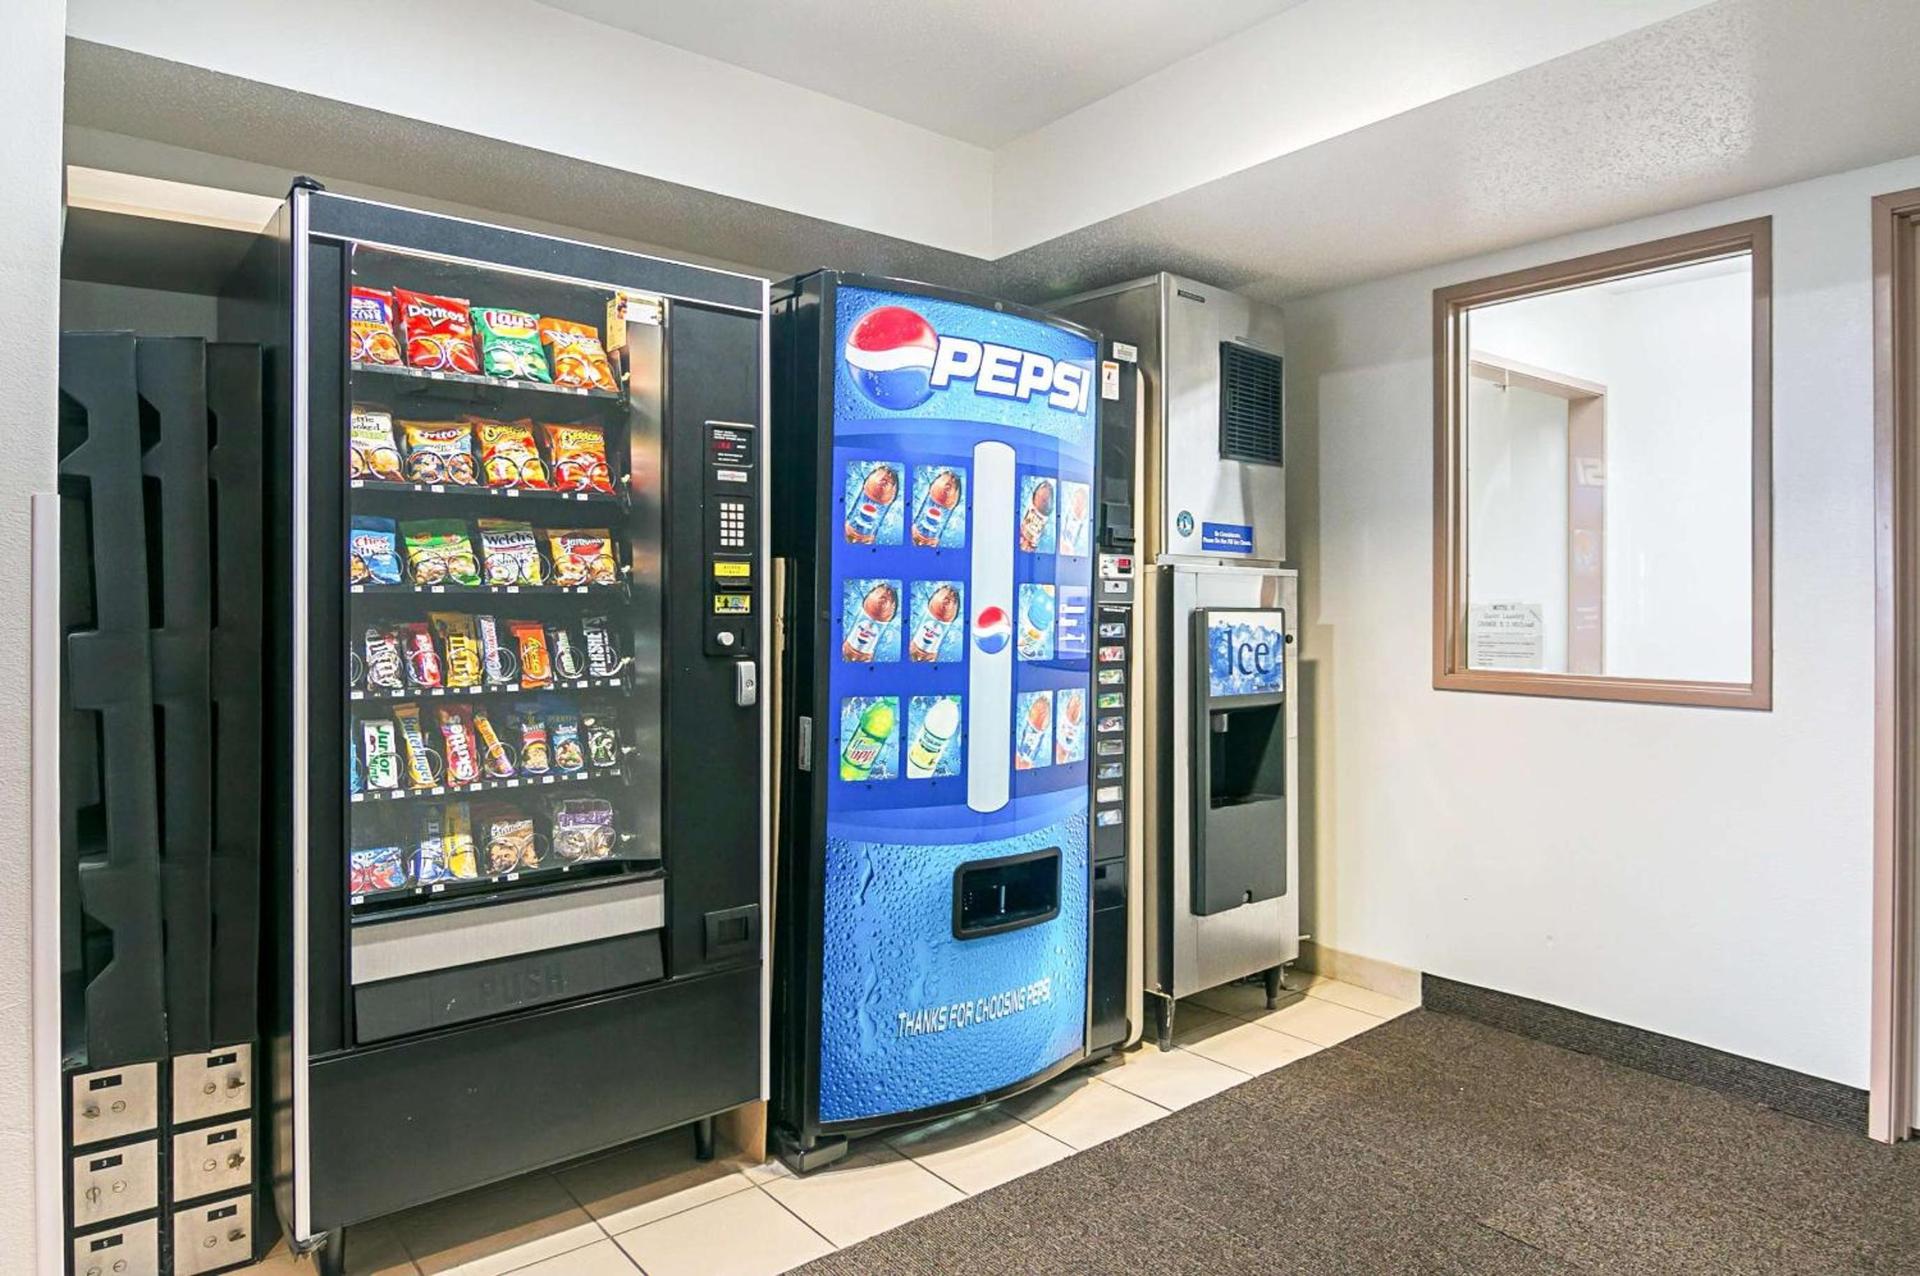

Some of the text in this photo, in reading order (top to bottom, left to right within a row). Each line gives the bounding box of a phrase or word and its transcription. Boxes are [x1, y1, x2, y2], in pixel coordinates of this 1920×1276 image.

[929, 336, 1091, 416] PEPSI
[377, 725, 390, 776] Junior
[898, 1006, 949, 1036] THANKS
[950, 1001, 976, 1028] FOR
[974, 987, 1025, 1024] CHOOSING
